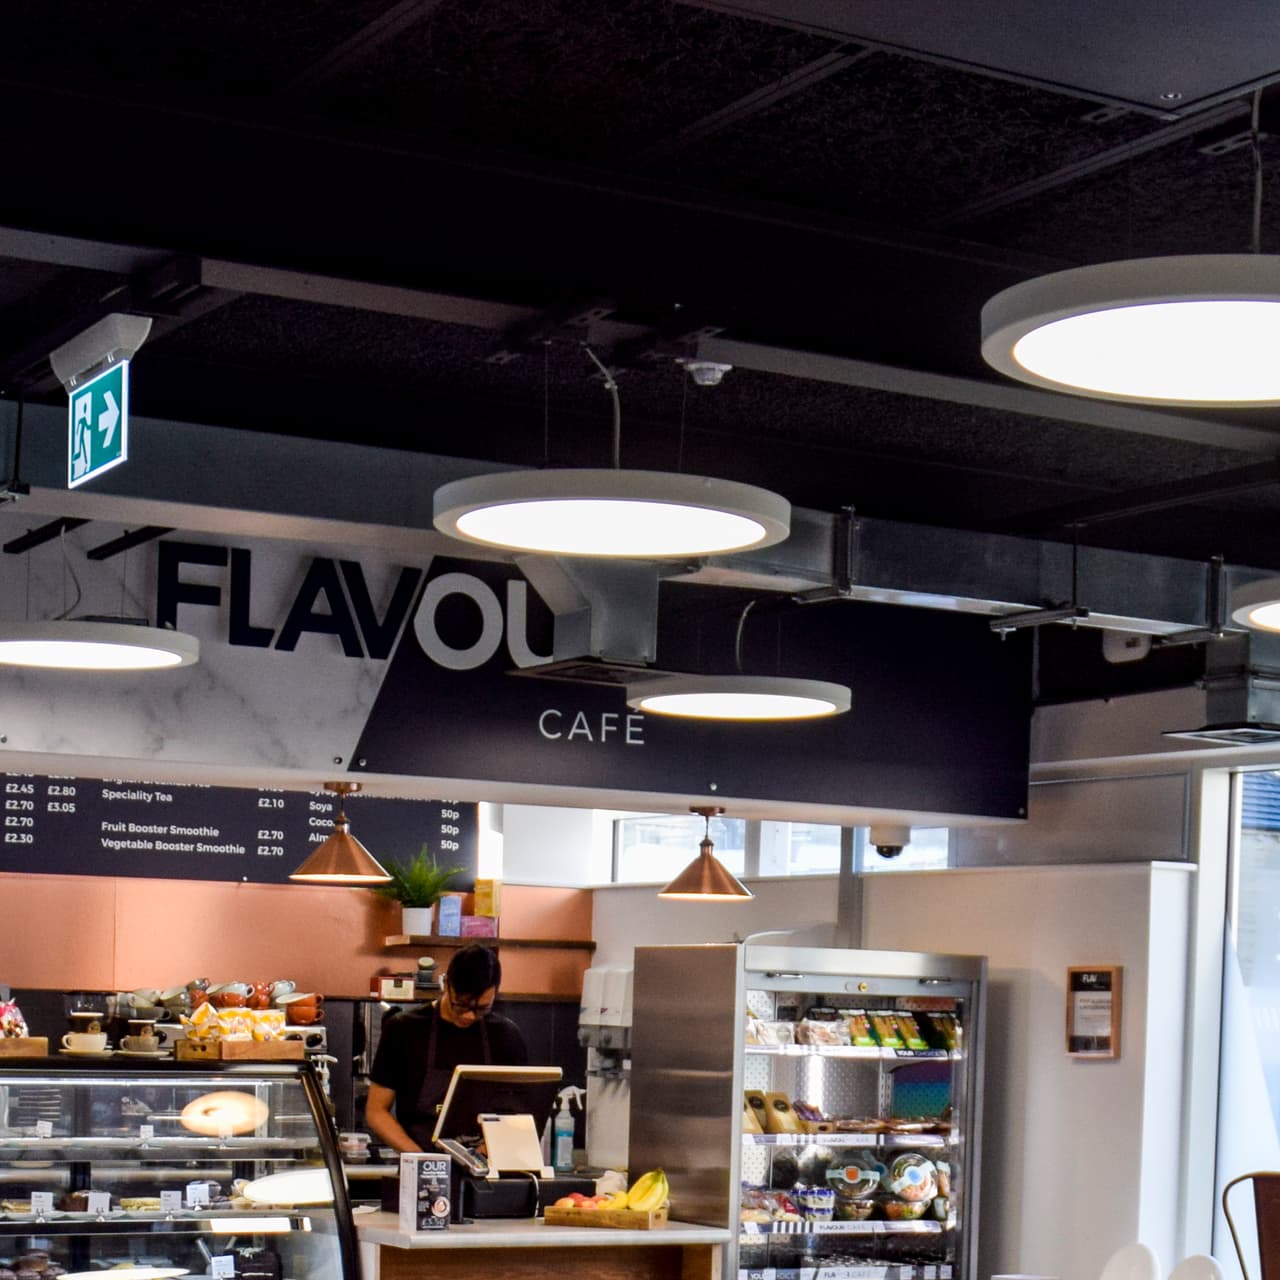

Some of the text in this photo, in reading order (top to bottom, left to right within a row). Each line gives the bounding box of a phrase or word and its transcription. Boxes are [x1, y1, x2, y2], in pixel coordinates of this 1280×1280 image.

[156, 540, 554, 671] FLAVOU
[6, 784, 34, 794] £2.45
[47, 786, 76, 796] £2.80
[102, 789, 173, 802] Speciality Tea
[5, 800, 34, 810] £2.70
[47, 802, 76, 813] £3.05
[258, 799, 284, 808] £2.10
[309, 802, 333, 812] Soya
[441, 809, 460, 819] 50p
[4, 816, 34, 827] £2.70
[101, 822, 219, 837] Fruit Booster Smoothie
[441, 825, 459, 835] 50p
[4, 833, 33, 844] £2.30
[257, 830, 284, 840] £2.70
[101, 838, 245, 855] Vegetable Booster Smoothie
[441, 840, 459, 850] 50p
[257, 846, 284, 857] £2.70
[423, 1161, 446, 1171] OUR
